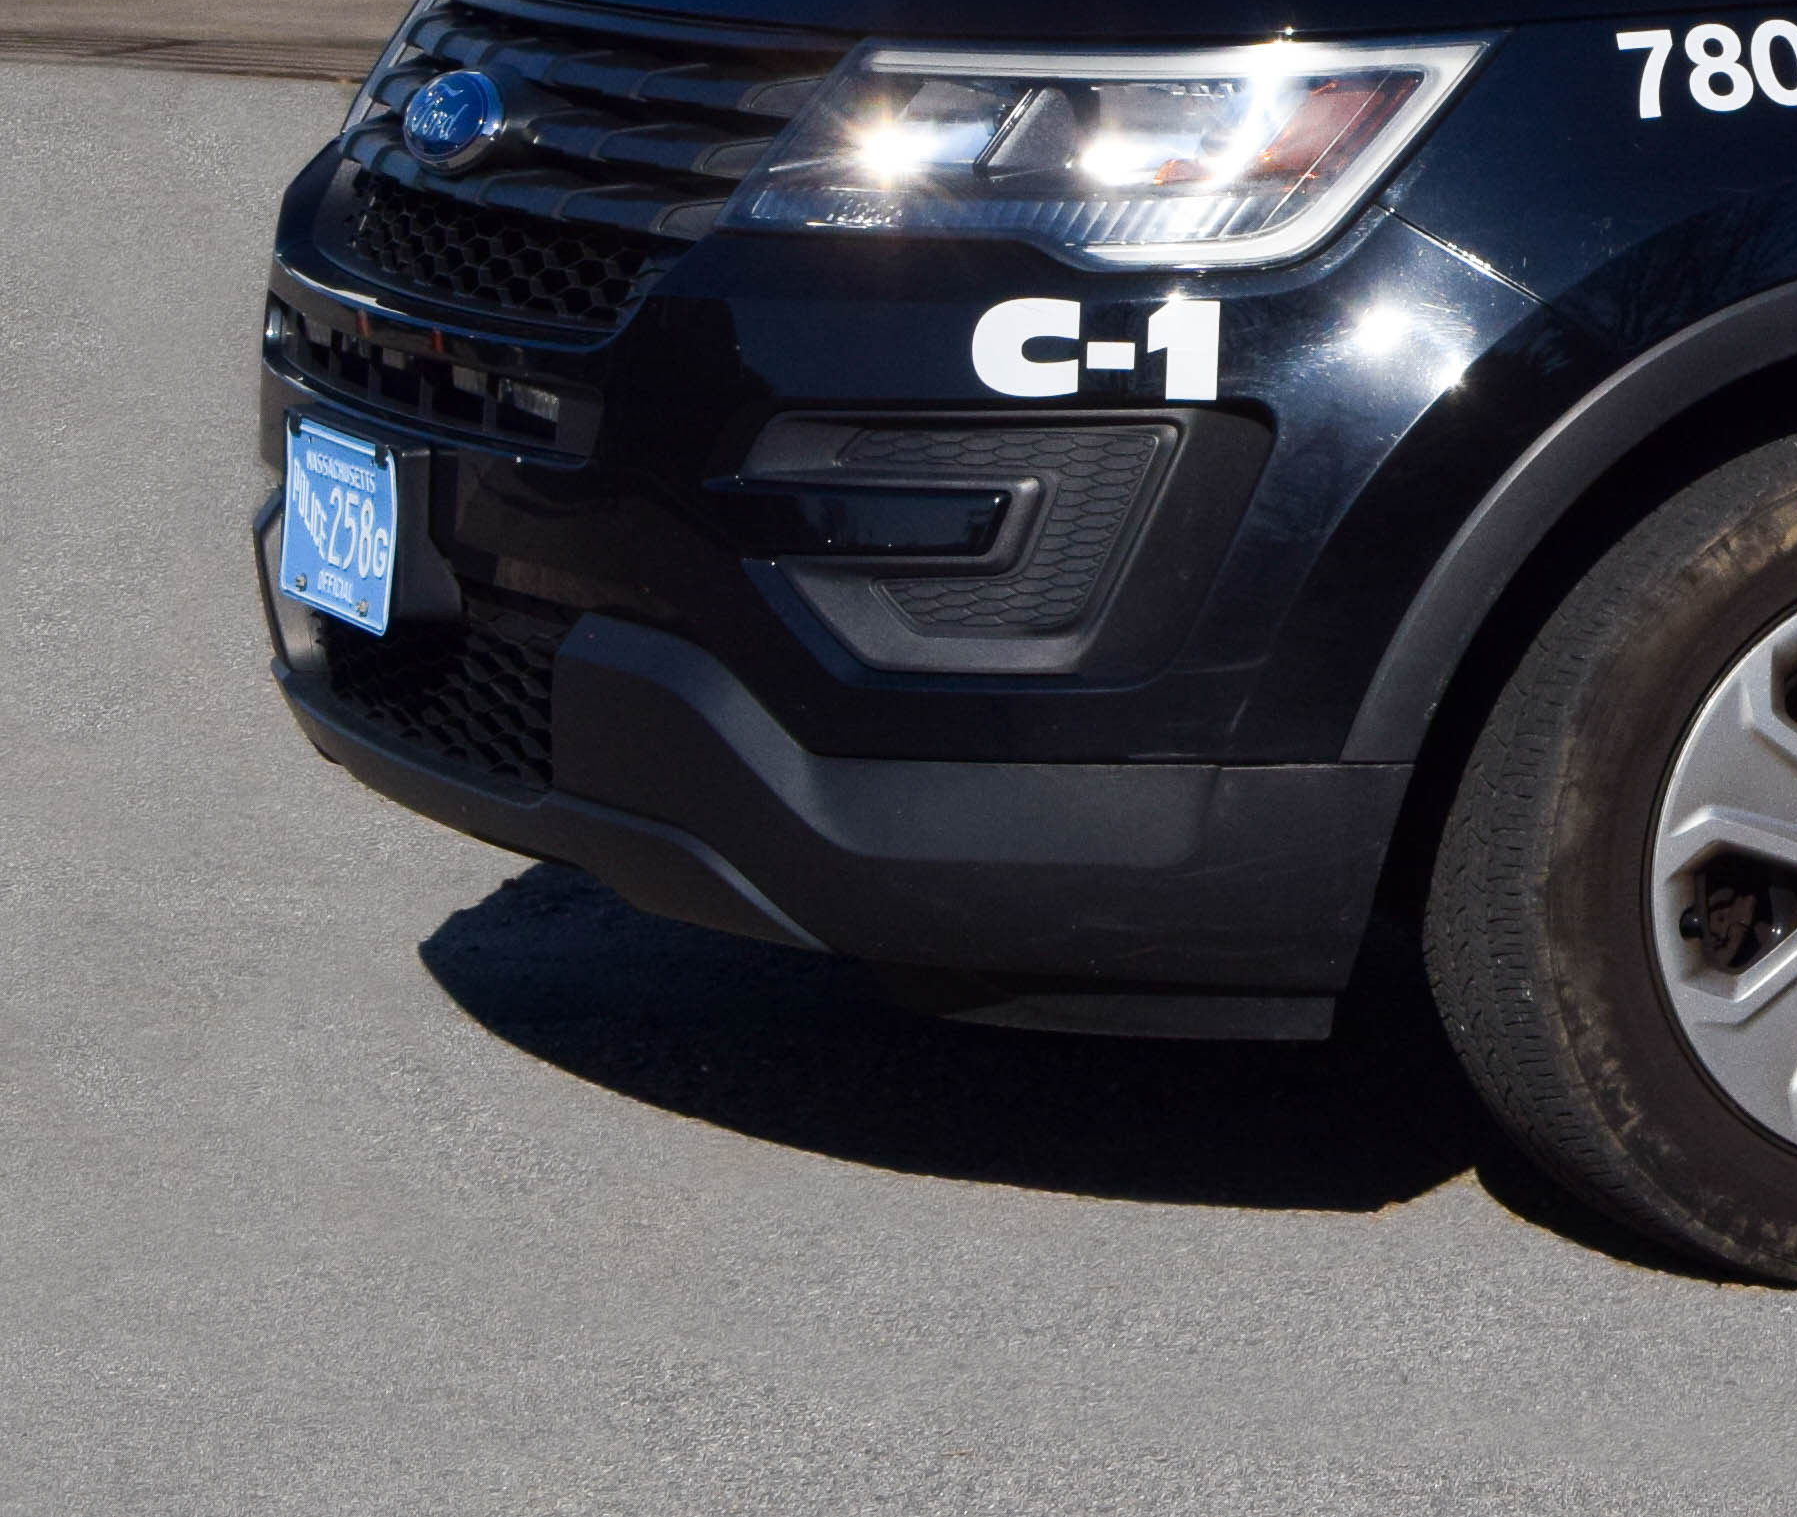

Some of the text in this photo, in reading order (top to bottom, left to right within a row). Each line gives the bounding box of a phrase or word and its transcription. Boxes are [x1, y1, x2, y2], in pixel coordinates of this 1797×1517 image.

[972, 297, 1221, 401] C-1
[306, 449, 376, 494] MASSACHUSETTS
[328, 485, 388, 579] 258G
[317, 570, 354, 604] OFFICIAL
